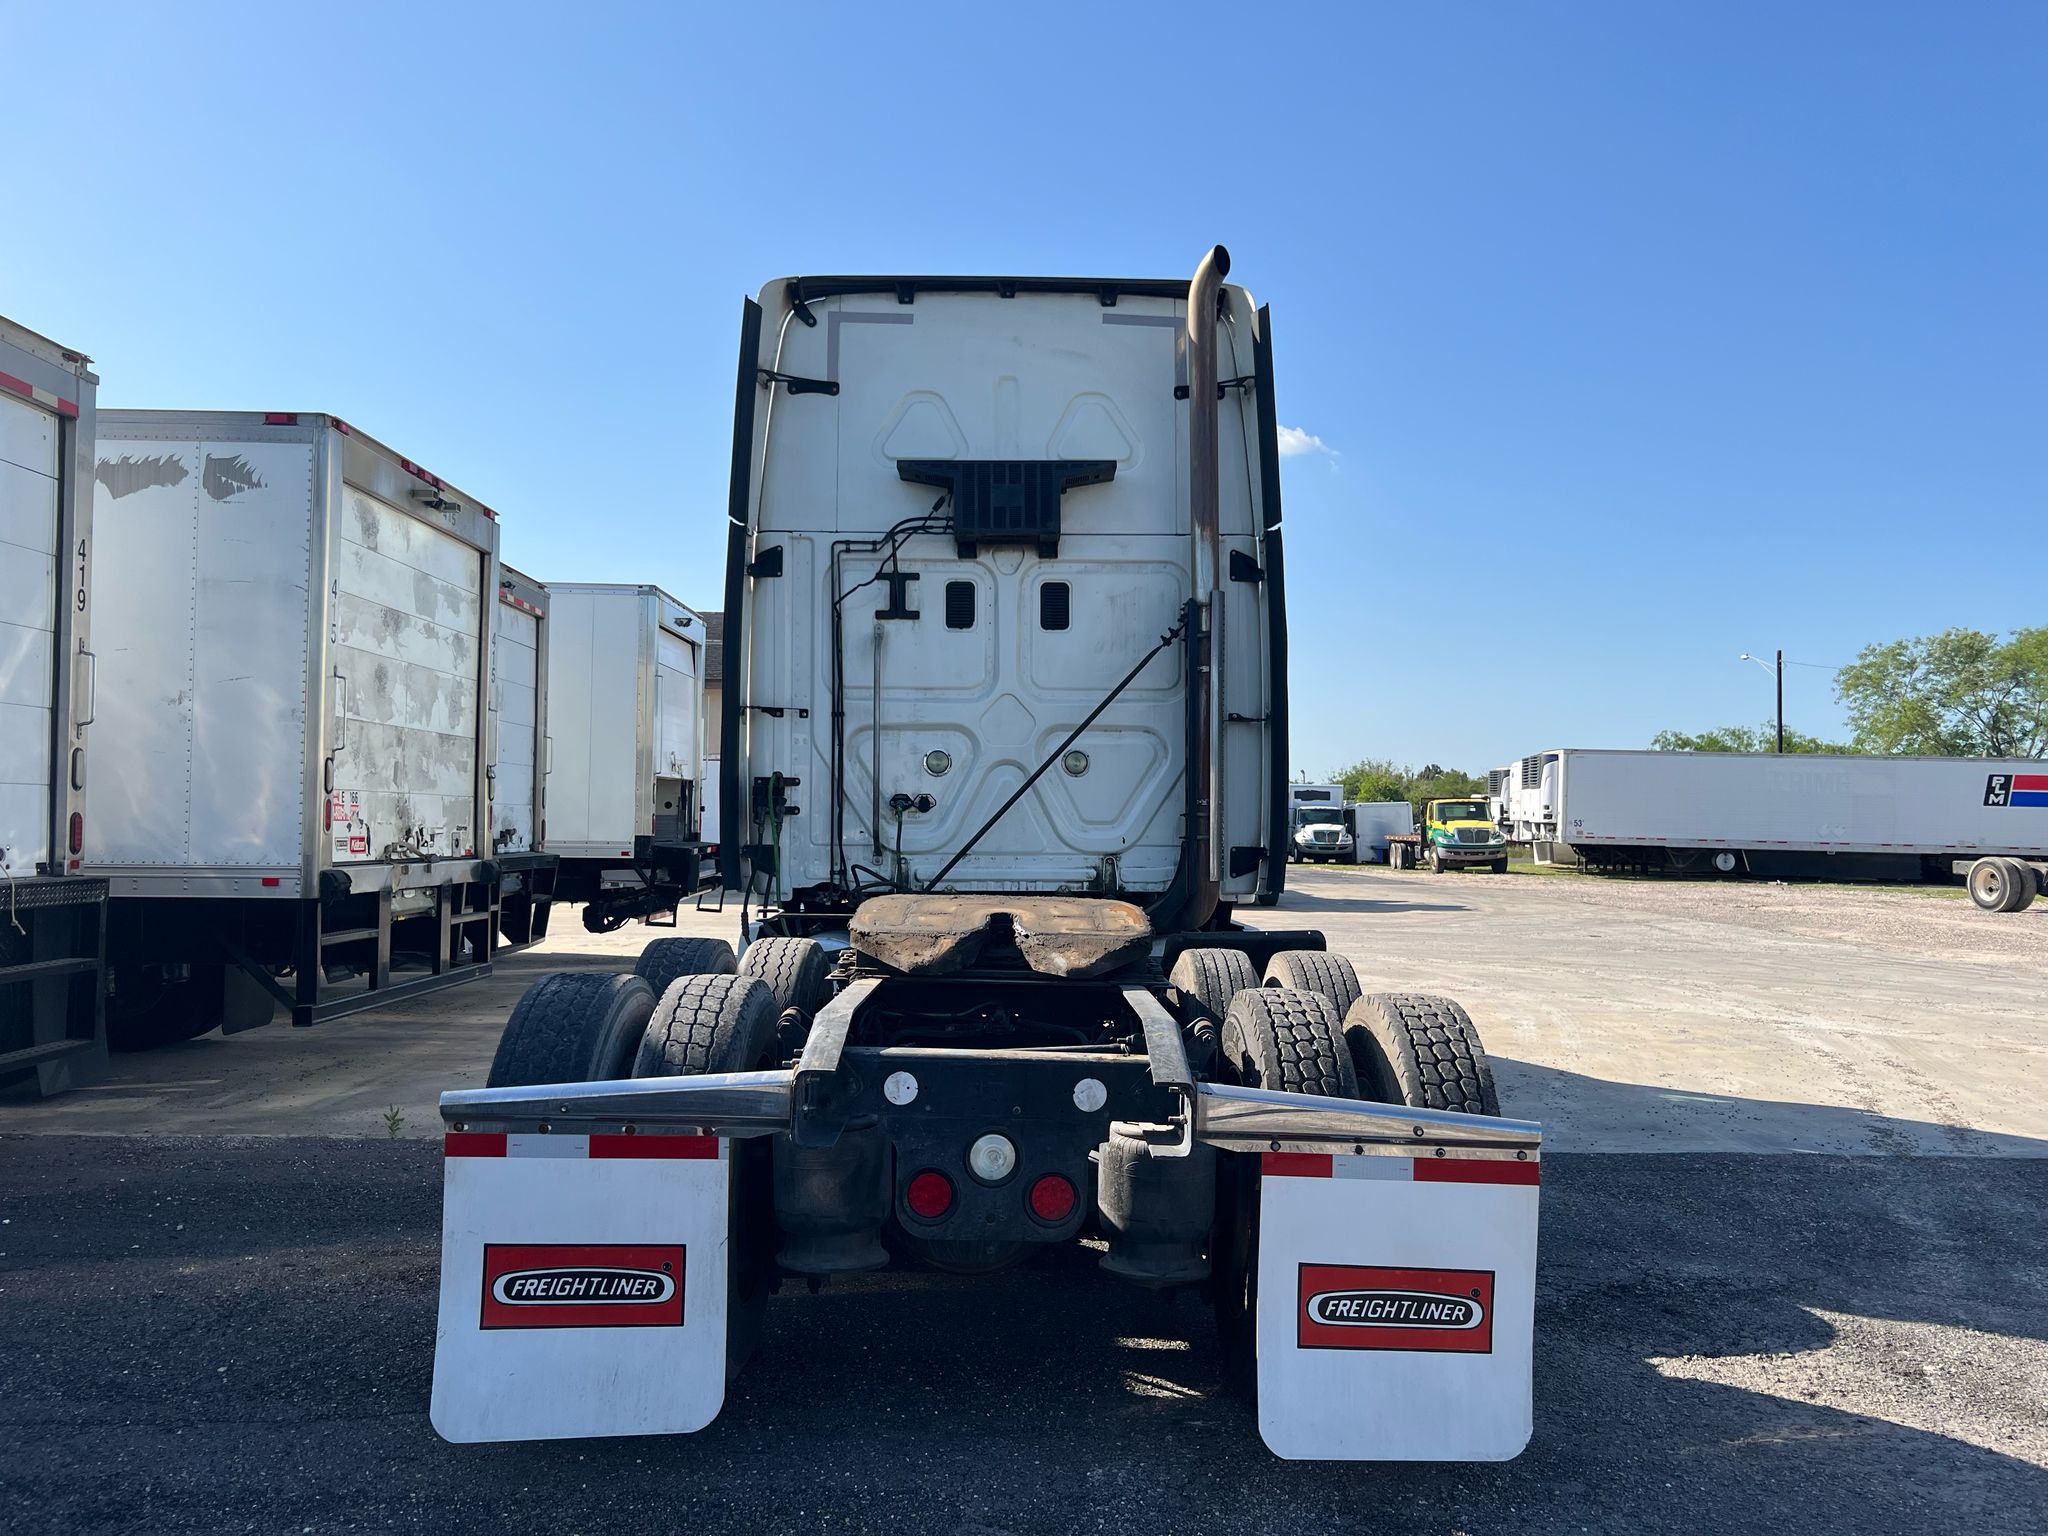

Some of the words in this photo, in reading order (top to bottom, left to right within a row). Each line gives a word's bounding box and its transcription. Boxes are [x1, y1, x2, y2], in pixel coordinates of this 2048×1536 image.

[77, 539, 86, 612] 419
[1988, 776, 2006, 804] PLM
[511, 1277, 657, 1297] FREIGHTLINER
[1325, 1299, 1466, 1321] FREIGHTLINER
